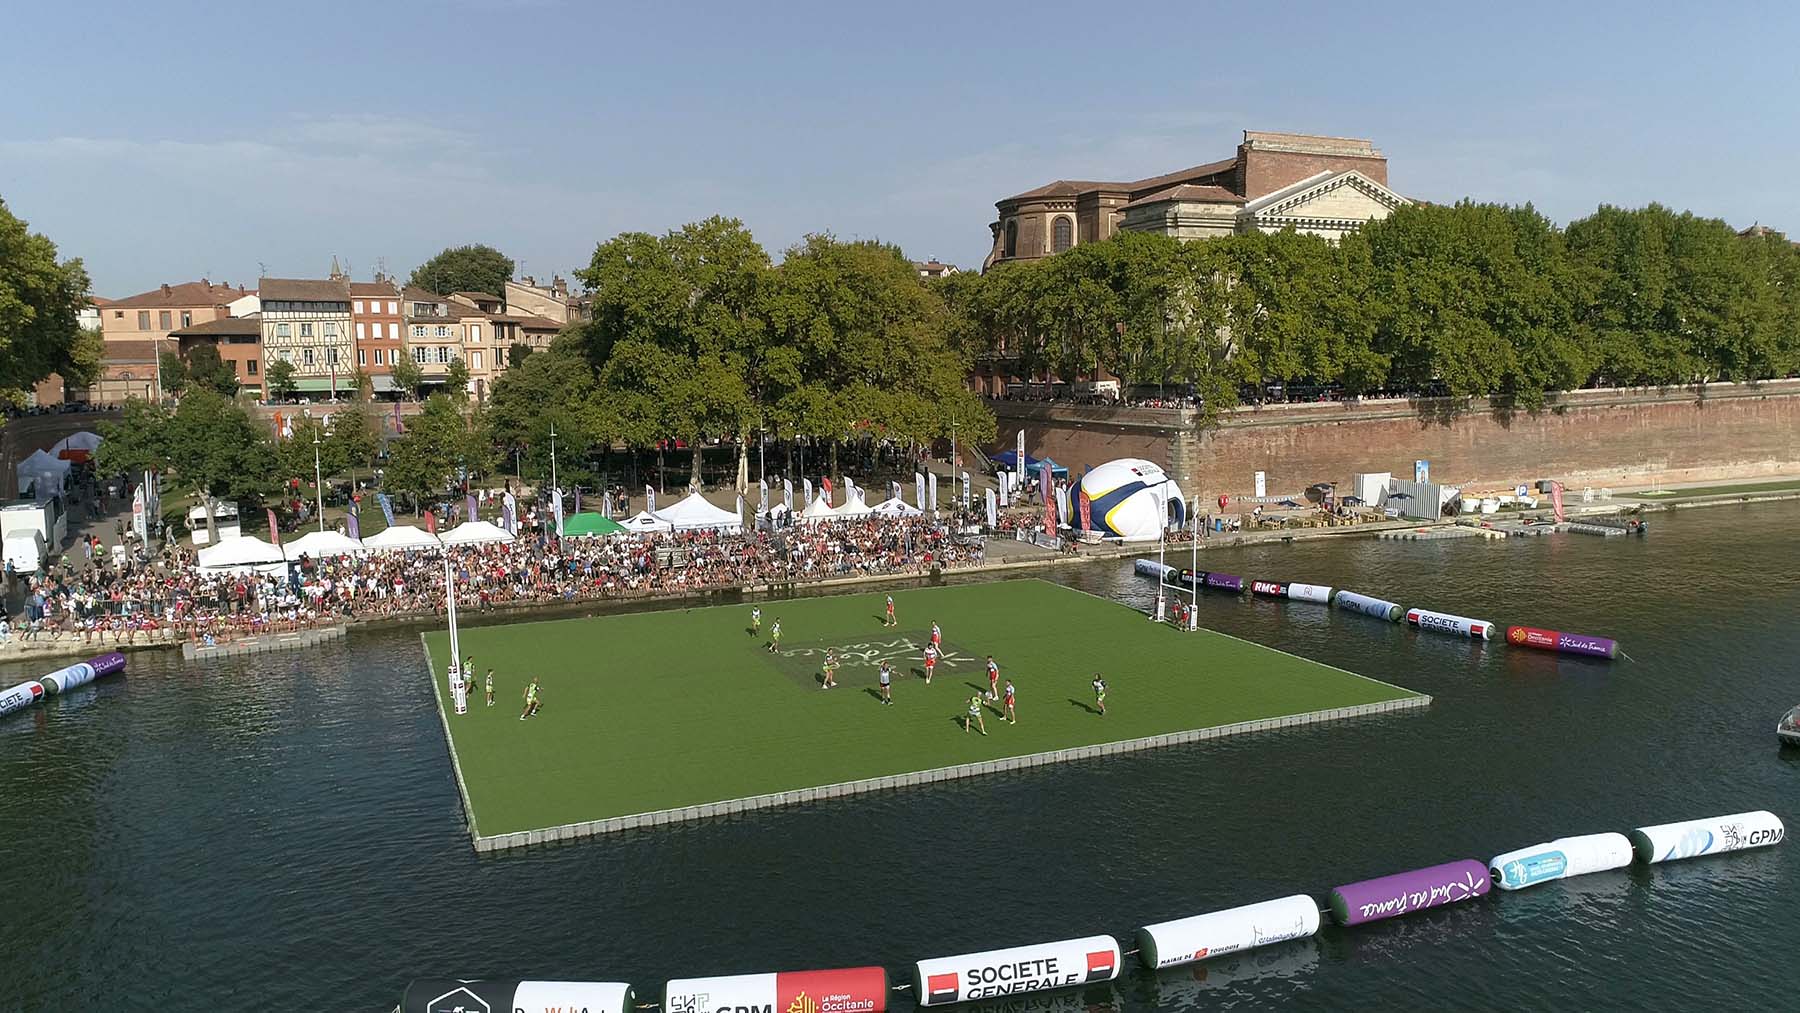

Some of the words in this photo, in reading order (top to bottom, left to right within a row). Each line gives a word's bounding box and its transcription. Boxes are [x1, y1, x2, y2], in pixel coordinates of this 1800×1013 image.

[1254, 582, 1277, 594] RMC
[1421, 615, 1460, 629] SOCIETE
[1750, 828, 1783, 845] GPM
[1409, 890, 1428, 910] de
[1426, 882, 1457, 908] Sud
[1360, 891, 1408, 918] France
[1160, 956, 1183, 965] MAIRIE
[1210, 943, 1240, 955] TOULOUSE
[967, 957, 1060, 986] SOCIETE
[821, 995, 829, 1003] La
[829, 994, 851, 1003] Région
[821, 998, 874, 1012] Occitanie
